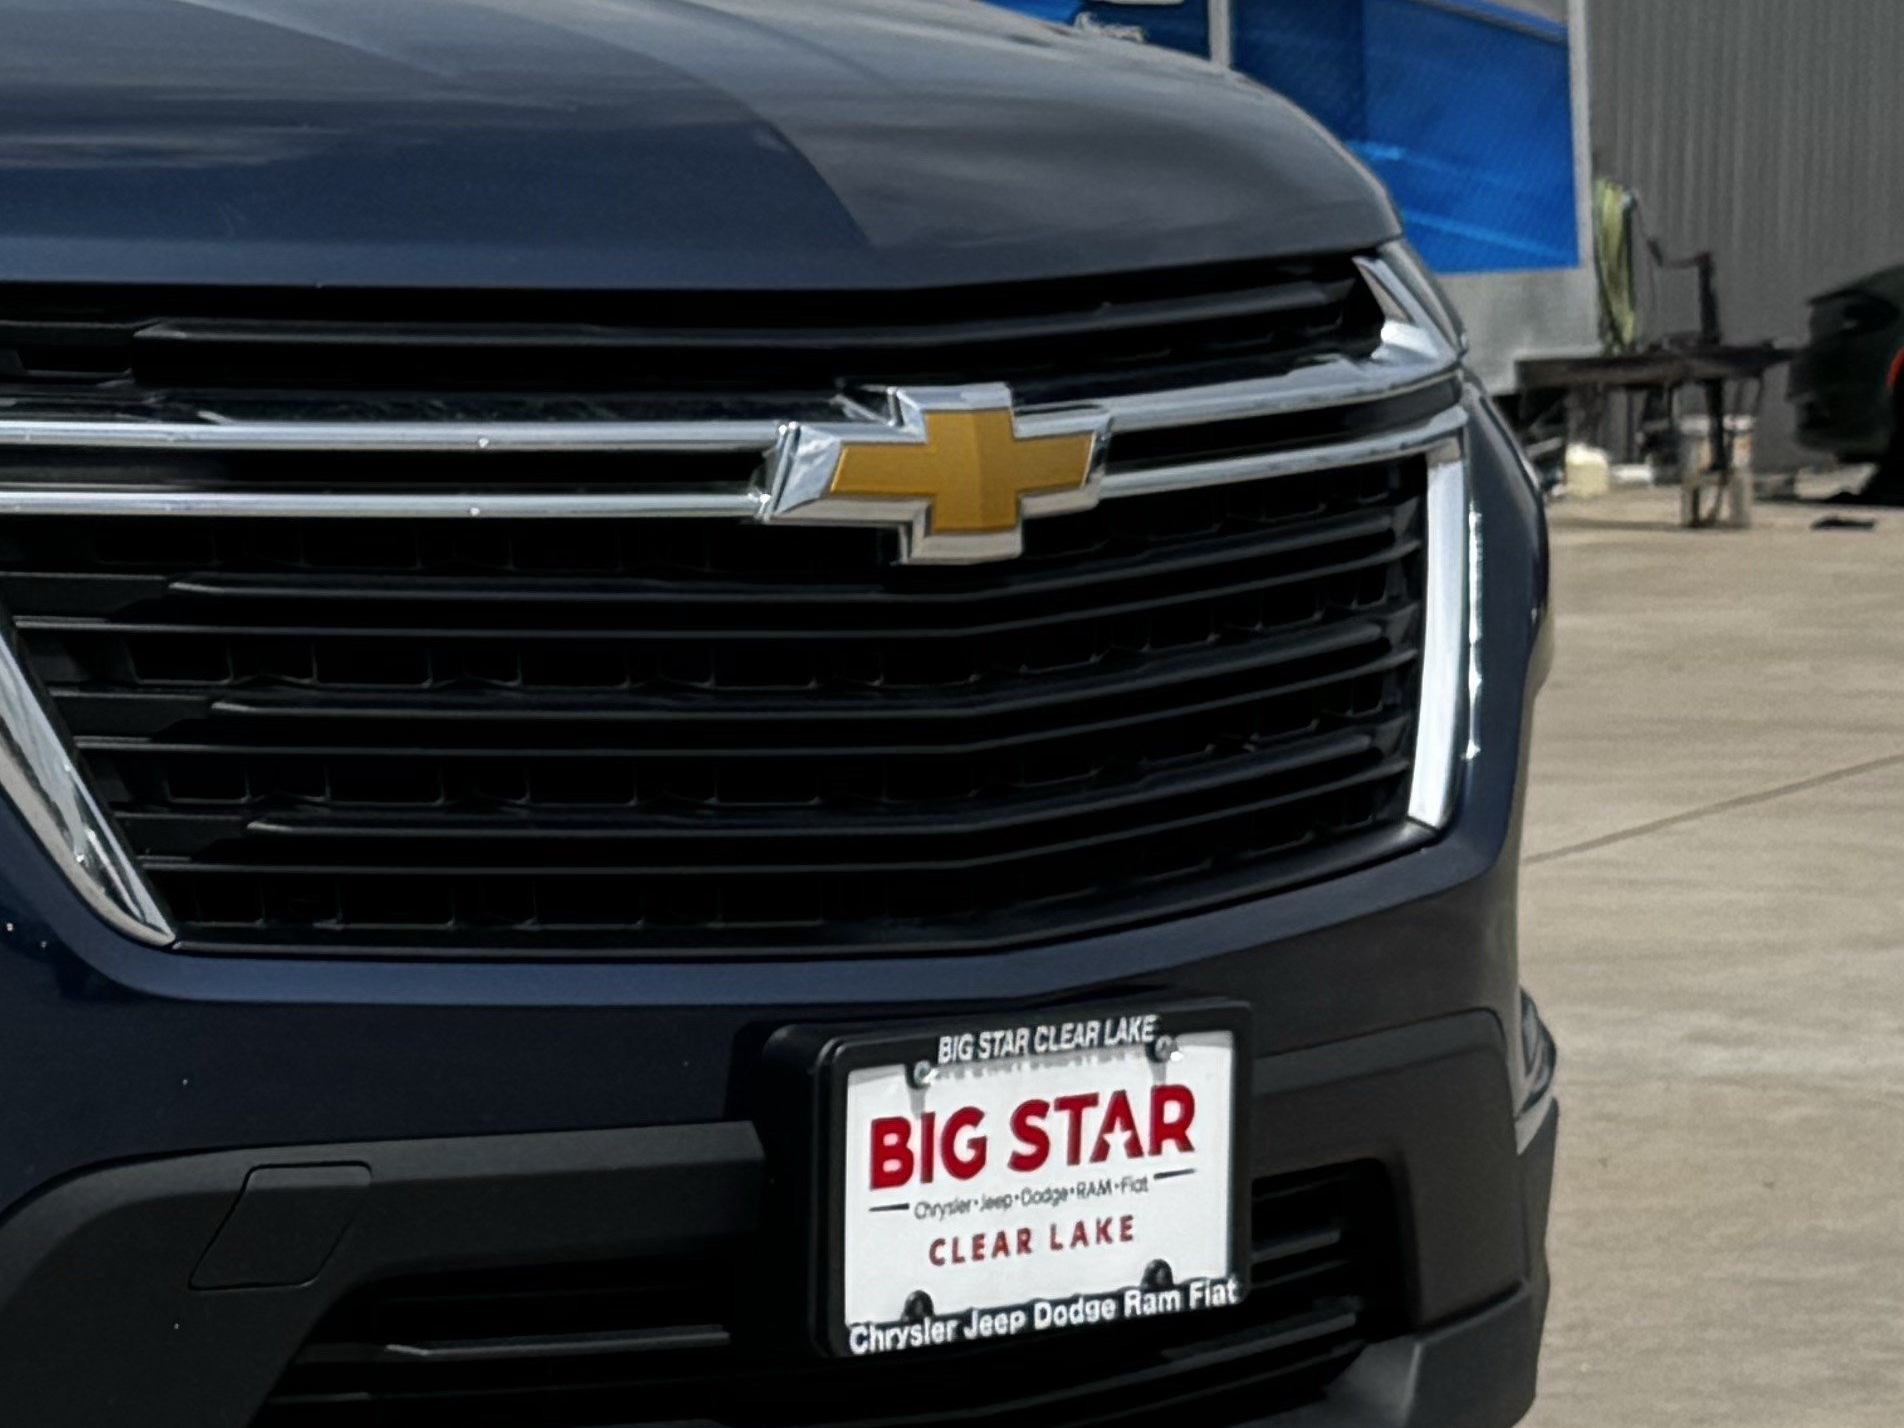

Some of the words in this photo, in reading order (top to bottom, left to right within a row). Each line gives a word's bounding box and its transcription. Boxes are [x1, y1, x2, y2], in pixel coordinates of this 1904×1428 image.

[938, 1033, 976, 1065] BIG
[977, 1027, 1030, 1060] STAR
[1033, 1020, 1100, 1053] CLEAR
[1103, 1013, 1159, 1046] LAKE
[869, 1105, 988, 1191] BIG
[1007, 1084, 1196, 1173] STAR
[928, 1226, 1033, 1267] CLEAR
[1049, 1213, 1136, 1251] LAKE
[848, 1317, 956, 1356] Chrysler
[963, 1307, 1027, 1341] Jeep
[1033, 1294, 1118, 1331] Dodge
[1123, 1285, 1182, 1317] Ram
[1188, 1275, 1240, 1309] Fiat
